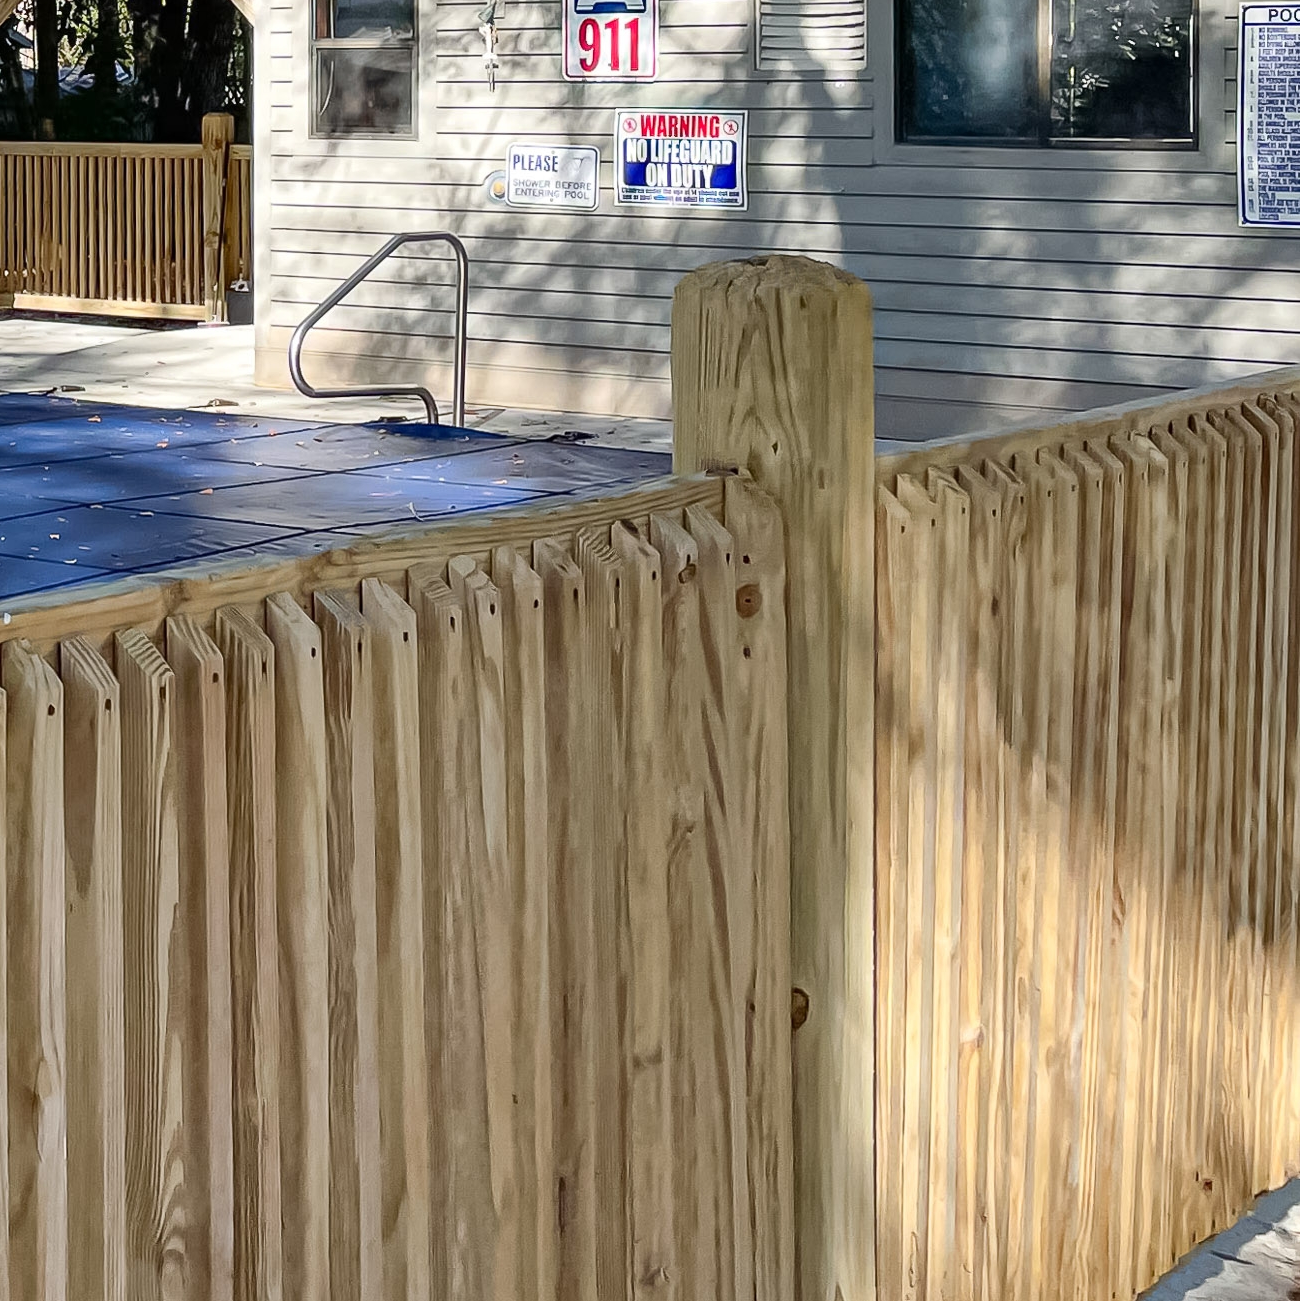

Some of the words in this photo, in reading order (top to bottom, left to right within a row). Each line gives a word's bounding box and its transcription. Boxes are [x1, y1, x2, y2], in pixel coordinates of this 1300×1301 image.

[578, 17, 640, 72] 911
[640, 114, 721, 138] WARNING
[512, 154, 559, 172] PLEASE
[626, 138, 648, 163] NO
[650, 138, 733, 165] LIFEGUARD
[512, 178, 551, 189] SHOWER
[555, 181, 592, 191] BEFORE
[645, 162, 668, 187] ON
[670, 163, 714, 189] DUTY
[514, 187, 560, 198] ENTERING
[564, 190, 590, 200] POOL
